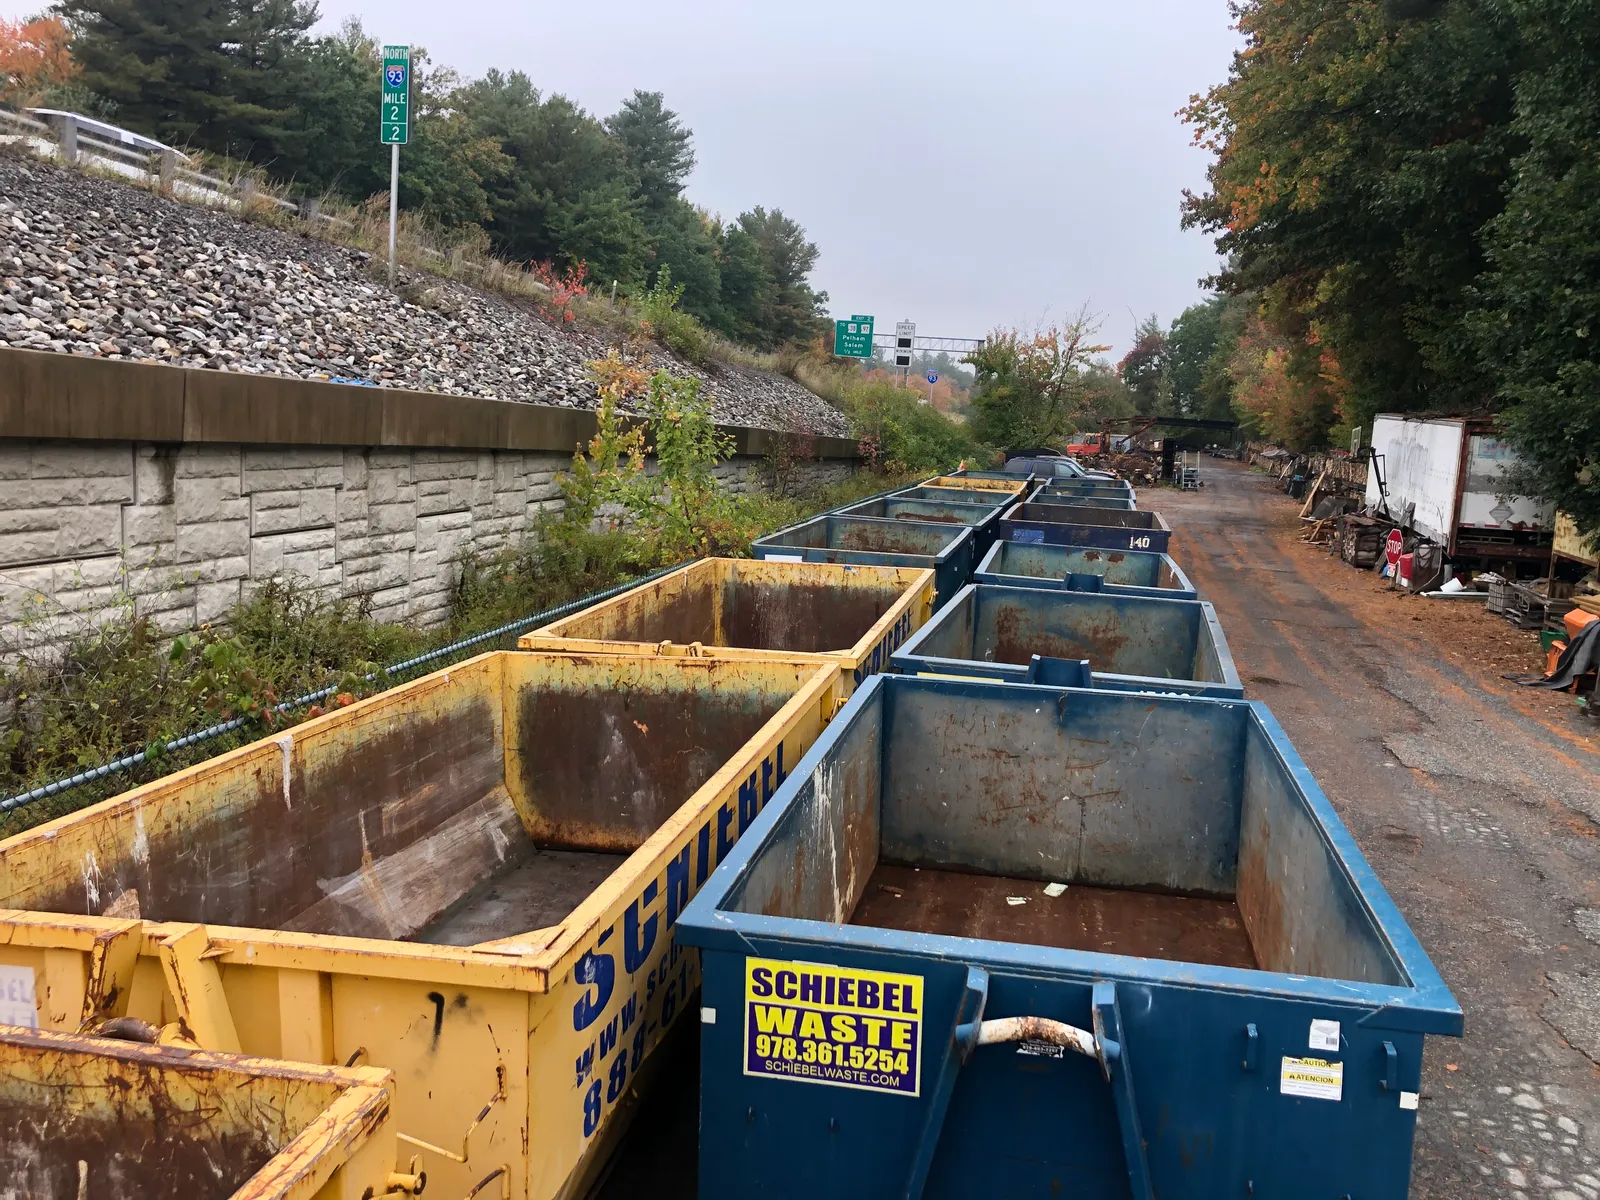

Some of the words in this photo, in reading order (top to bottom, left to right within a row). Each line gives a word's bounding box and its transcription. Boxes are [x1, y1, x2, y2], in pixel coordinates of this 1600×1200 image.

[384, 47, 408, 60] NORTH
[388, 71, 402, 82] 93
[384, 93, 406, 104] MILE
[391, 106, 399, 120] 2
[1129, 535, 1151, 550] 140
[1388, 540, 1401, 554] STOP
[573, 740, 787, 1032] SCHIEBEL
[751, 967, 918, 1015] SCHIEBEL
[754, 1004, 913, 1051] WASTE
[755, 1034, 909, 1076] 978.361.5254
[1299, 1059, 1331, 1068] CAUTION
[765, 1059, 901, 1088] SCHIEBELWASTE.COM
[1296, 1074, 1333, 1083] ATENCION
